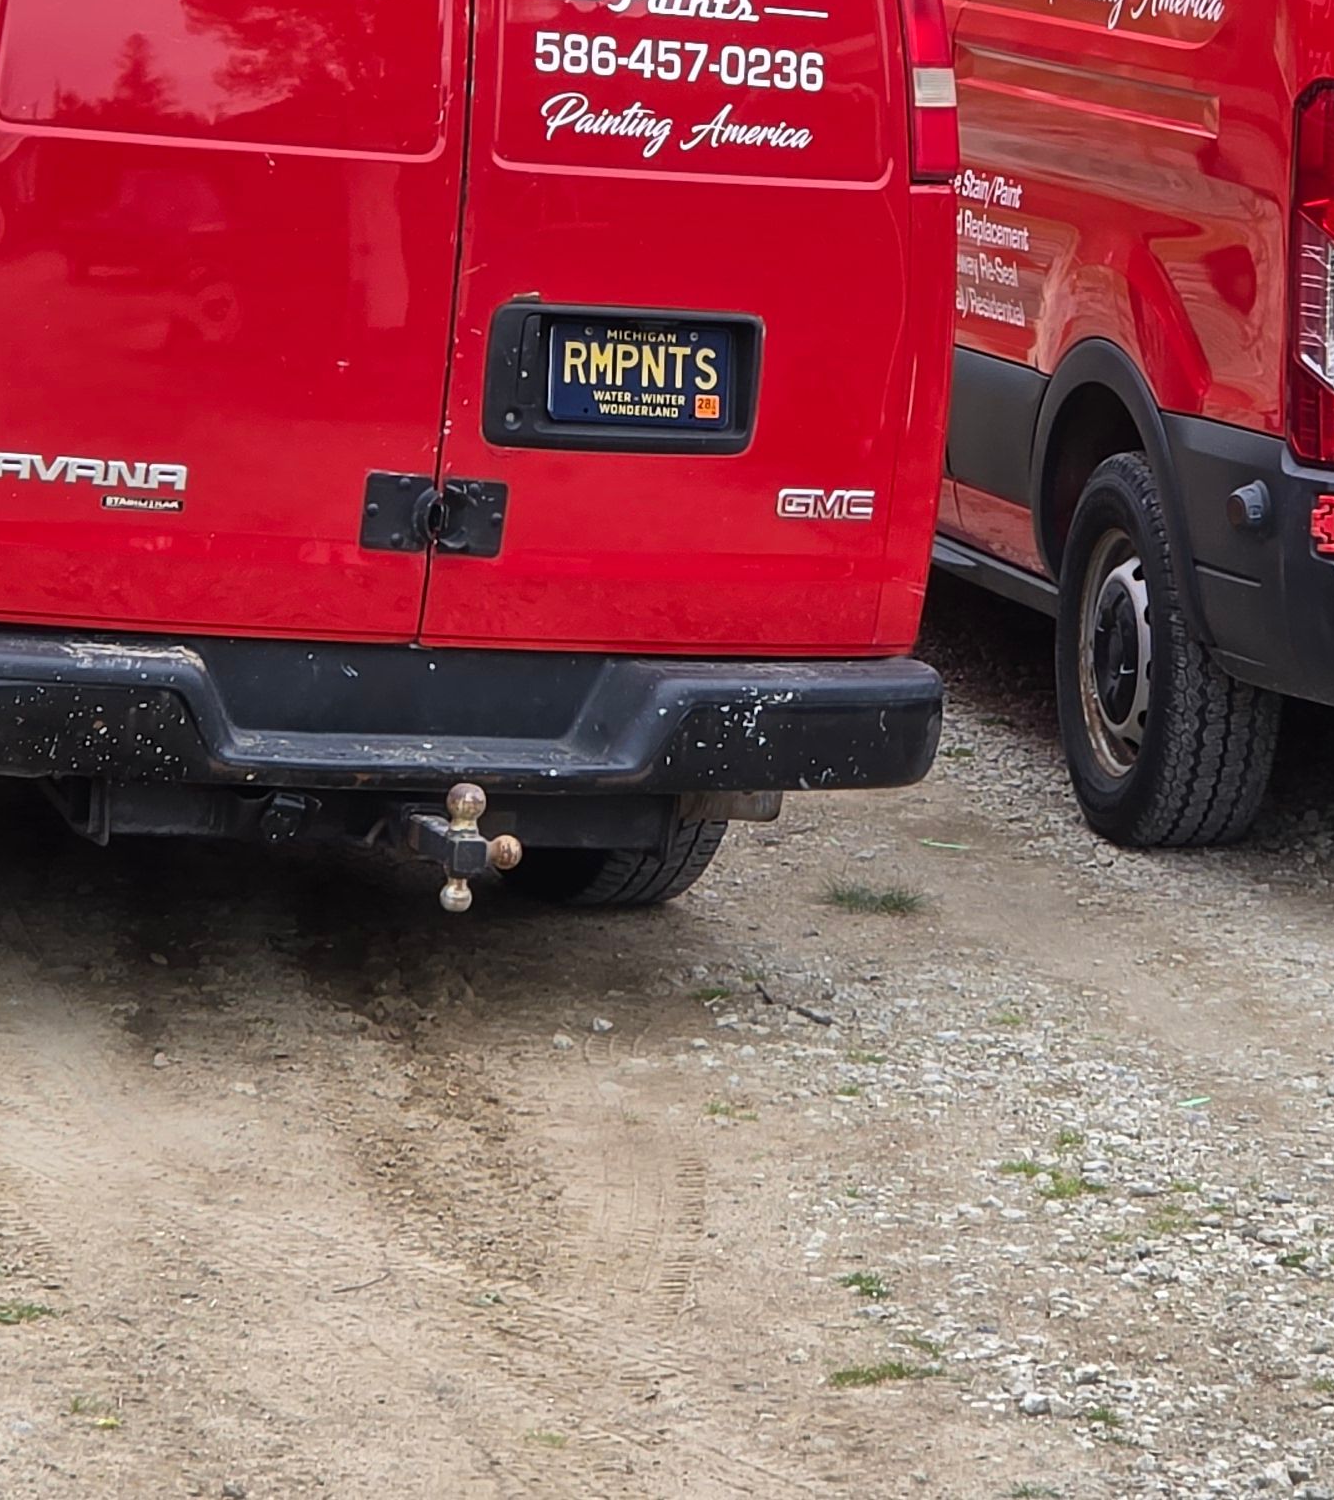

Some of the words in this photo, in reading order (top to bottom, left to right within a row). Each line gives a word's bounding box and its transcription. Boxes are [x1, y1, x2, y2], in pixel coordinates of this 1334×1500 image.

[533, 31, 825, 93] 586-457-0236
[540, 92, 672, 159] Painting
[679, 103, 813, 152] America
[961, 169, 1023, 209] Stain/Paint
[964, 209, 1029, 252] Replacement
[606, 329, 677, 344] MICHIGAN
[563, 341, 718, 390] RMPNTS
[593, 390, 633, 402] WATER
[641, 393, 686, 405] WINTER
[599, 403, 679, 418] WONDERLAND
[776, 488, 876, 520] GMC
